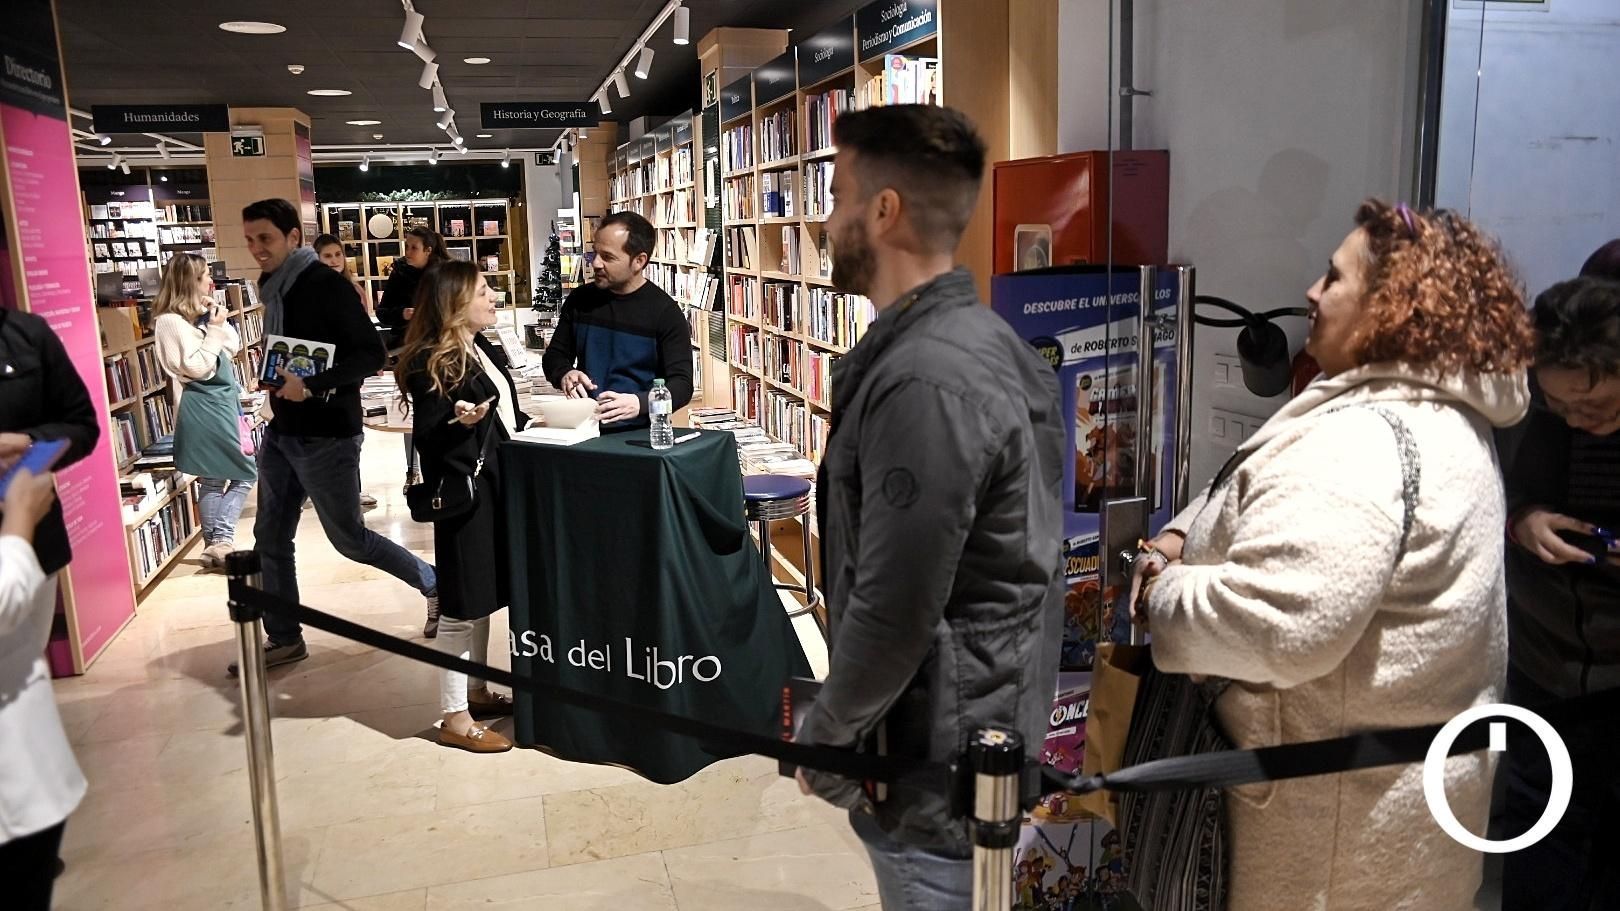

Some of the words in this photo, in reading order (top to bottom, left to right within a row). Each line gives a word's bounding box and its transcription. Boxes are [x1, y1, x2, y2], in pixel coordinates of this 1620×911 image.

[862, 32, 888, 51] Periodismo
[892, 9, 932, 37] Comunicación
[123, 111, 200, 122] Humanidades
[493, 110, 532, 119] Historia
[533, 111, 540, 121] y
[540, 108, 587, 121] Geografía
[1023, 299, 1077, 314] DESCUBRE
[1078, 298, 1090, 308] EL
[1154, 288, 1171, 300] LOS
[1070, 342, 1083, 354] de
[567, 639, 611, 672] del
[625, 636, 722, 690] Libro
